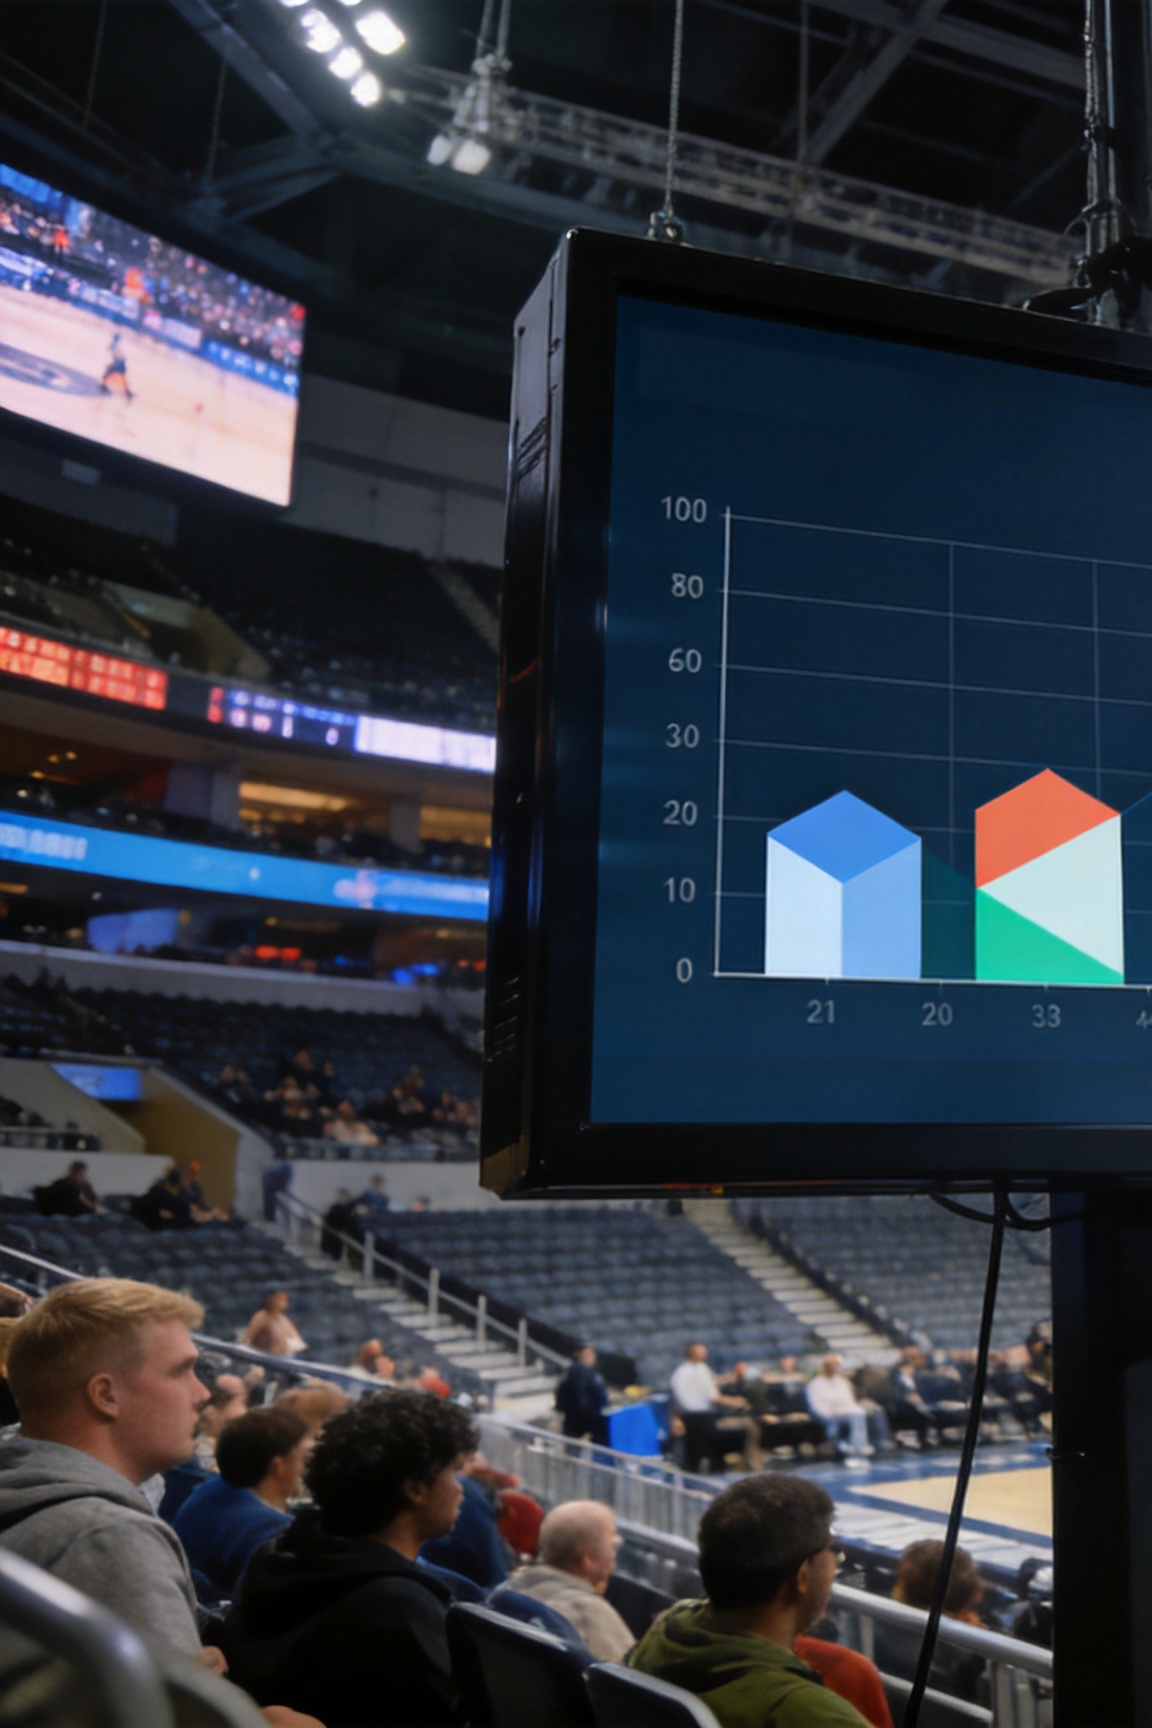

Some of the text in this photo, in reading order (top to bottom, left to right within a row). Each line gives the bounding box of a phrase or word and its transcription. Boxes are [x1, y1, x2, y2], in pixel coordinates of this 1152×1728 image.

[661, 498, 707, 523] 100
[671, 573, 704, 598] 80
[668, 648, 702, 673] 60
[666, 723, 699, 748] 30
[663, 800, 697, 826] 20
[664, 877, 696, 903] 10
[676, 957, 693, 983] 0
[806, 1000, 835, 1024] 21
[921, 1002, 953, 1027] 20
[1032, 1003, 1062, 1028] 33
